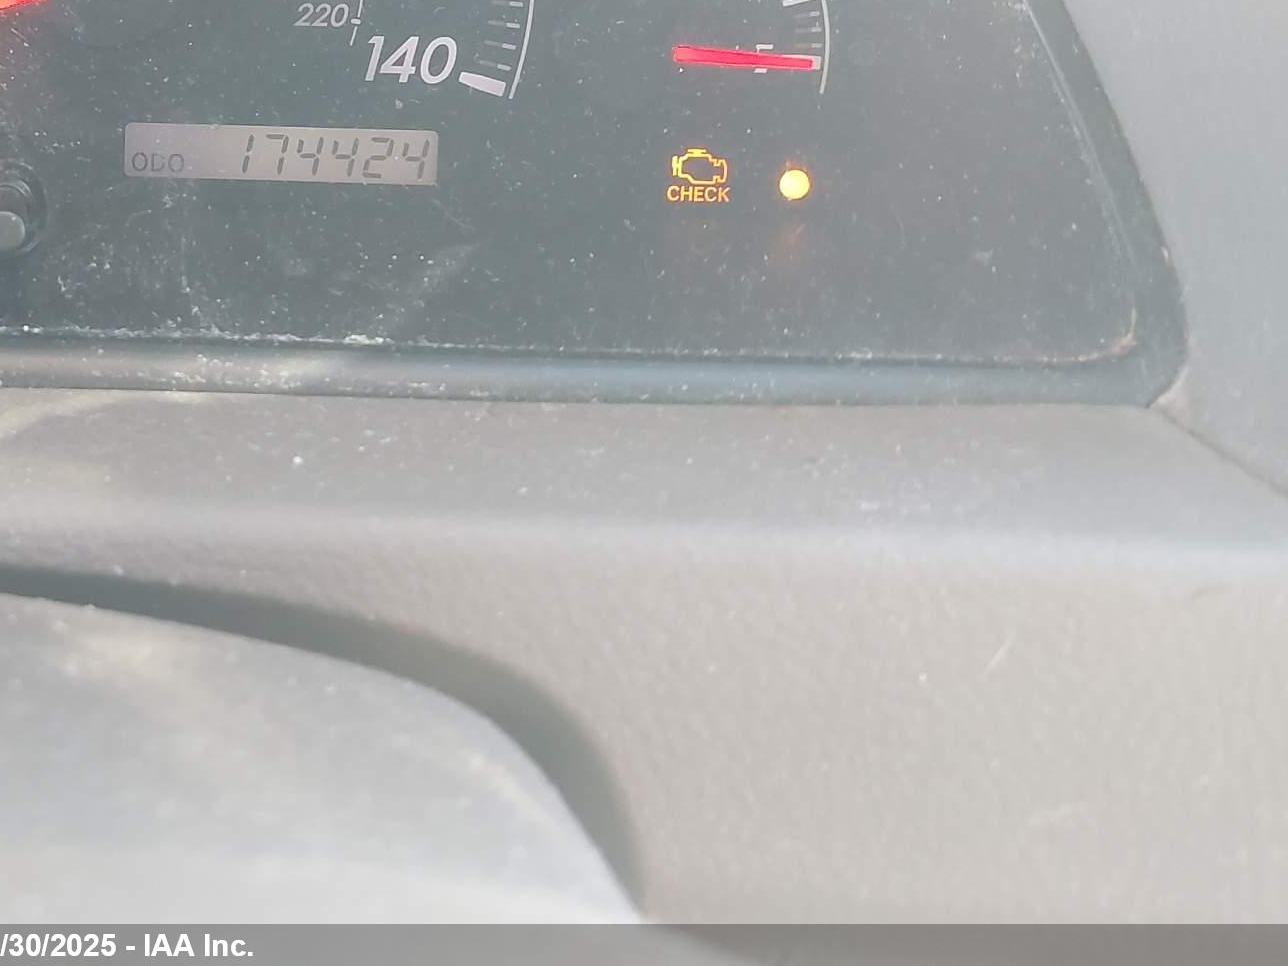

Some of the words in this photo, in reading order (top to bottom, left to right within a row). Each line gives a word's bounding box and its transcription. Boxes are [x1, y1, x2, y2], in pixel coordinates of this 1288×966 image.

[294, 2, 350, 29] 220
[364, 35, 458, 85] 140
[131, 151, 185, 173] ODO
[241, 133, 430, 180] 174424
[666, 186, 731, 203] CHECK
